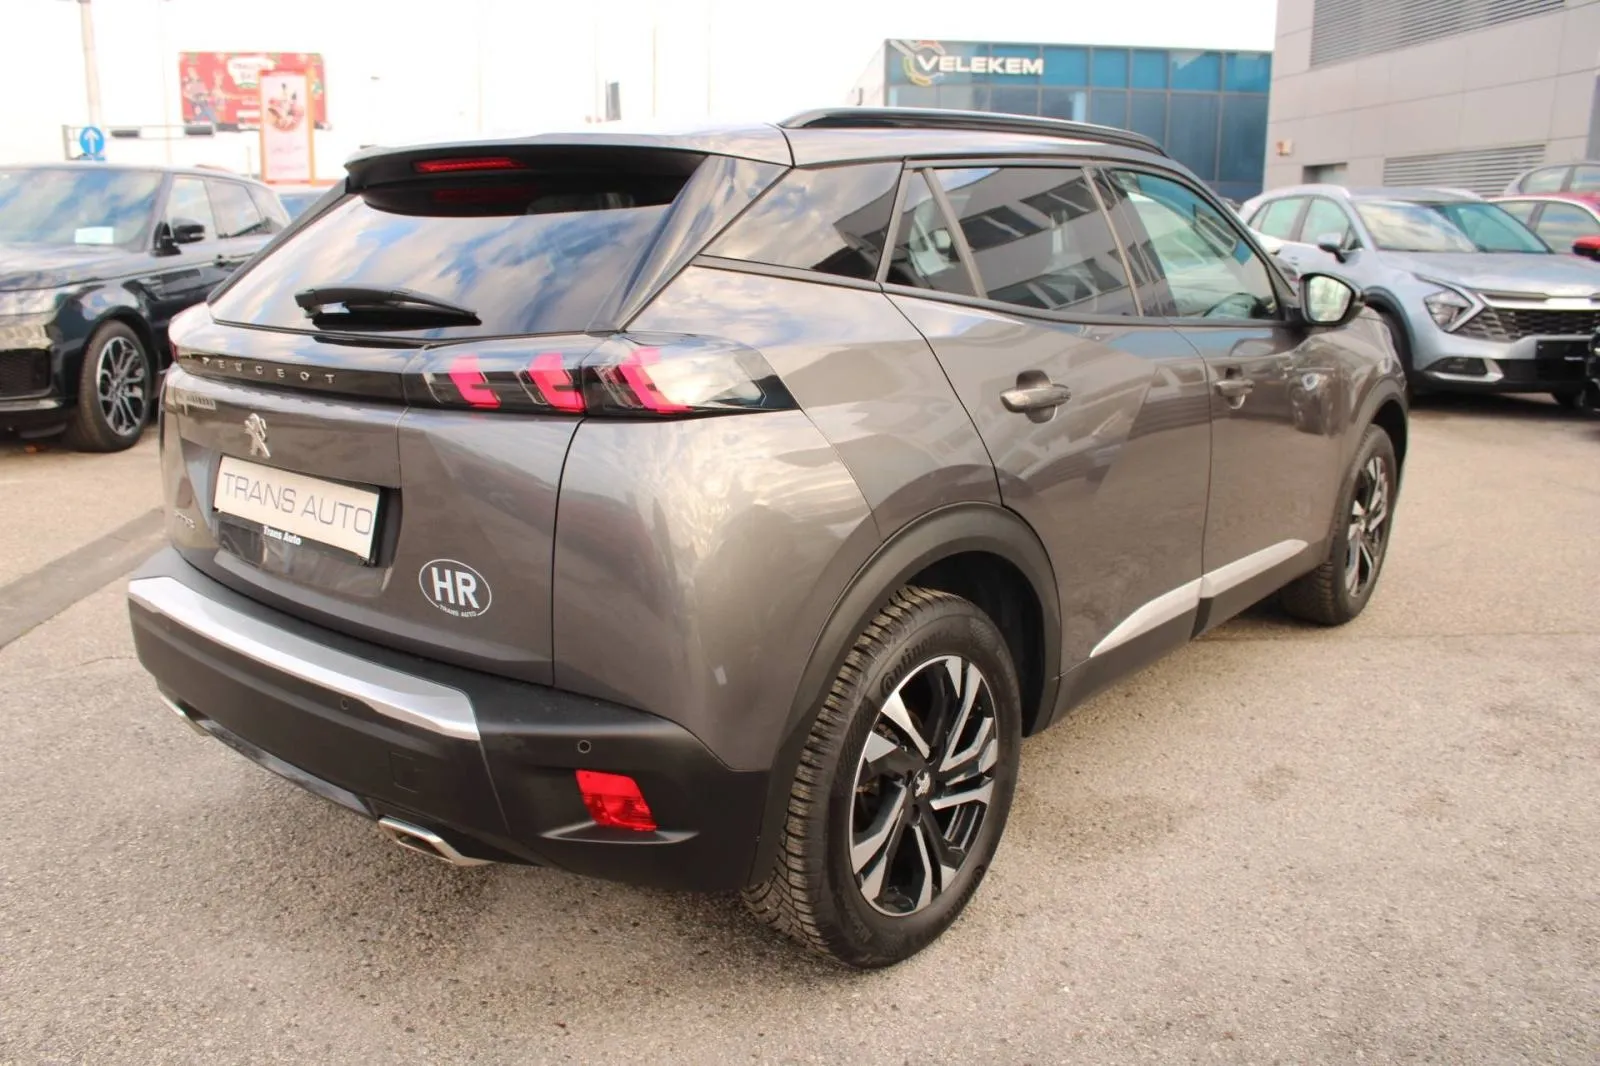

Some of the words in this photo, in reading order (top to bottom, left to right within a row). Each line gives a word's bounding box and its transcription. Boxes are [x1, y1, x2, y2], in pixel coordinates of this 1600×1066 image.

[916, 55, 1044, 75] VELEKEM
[202, 356, 335, 384] PEUGEOT
[223, 472, 297, 514] TRANS
[301, 495, 373, 536] AUTO
[263, 525, 283, 540] Trans
[283, 531, 302, 546] Auto
[431, 566, 480, 609] HR
